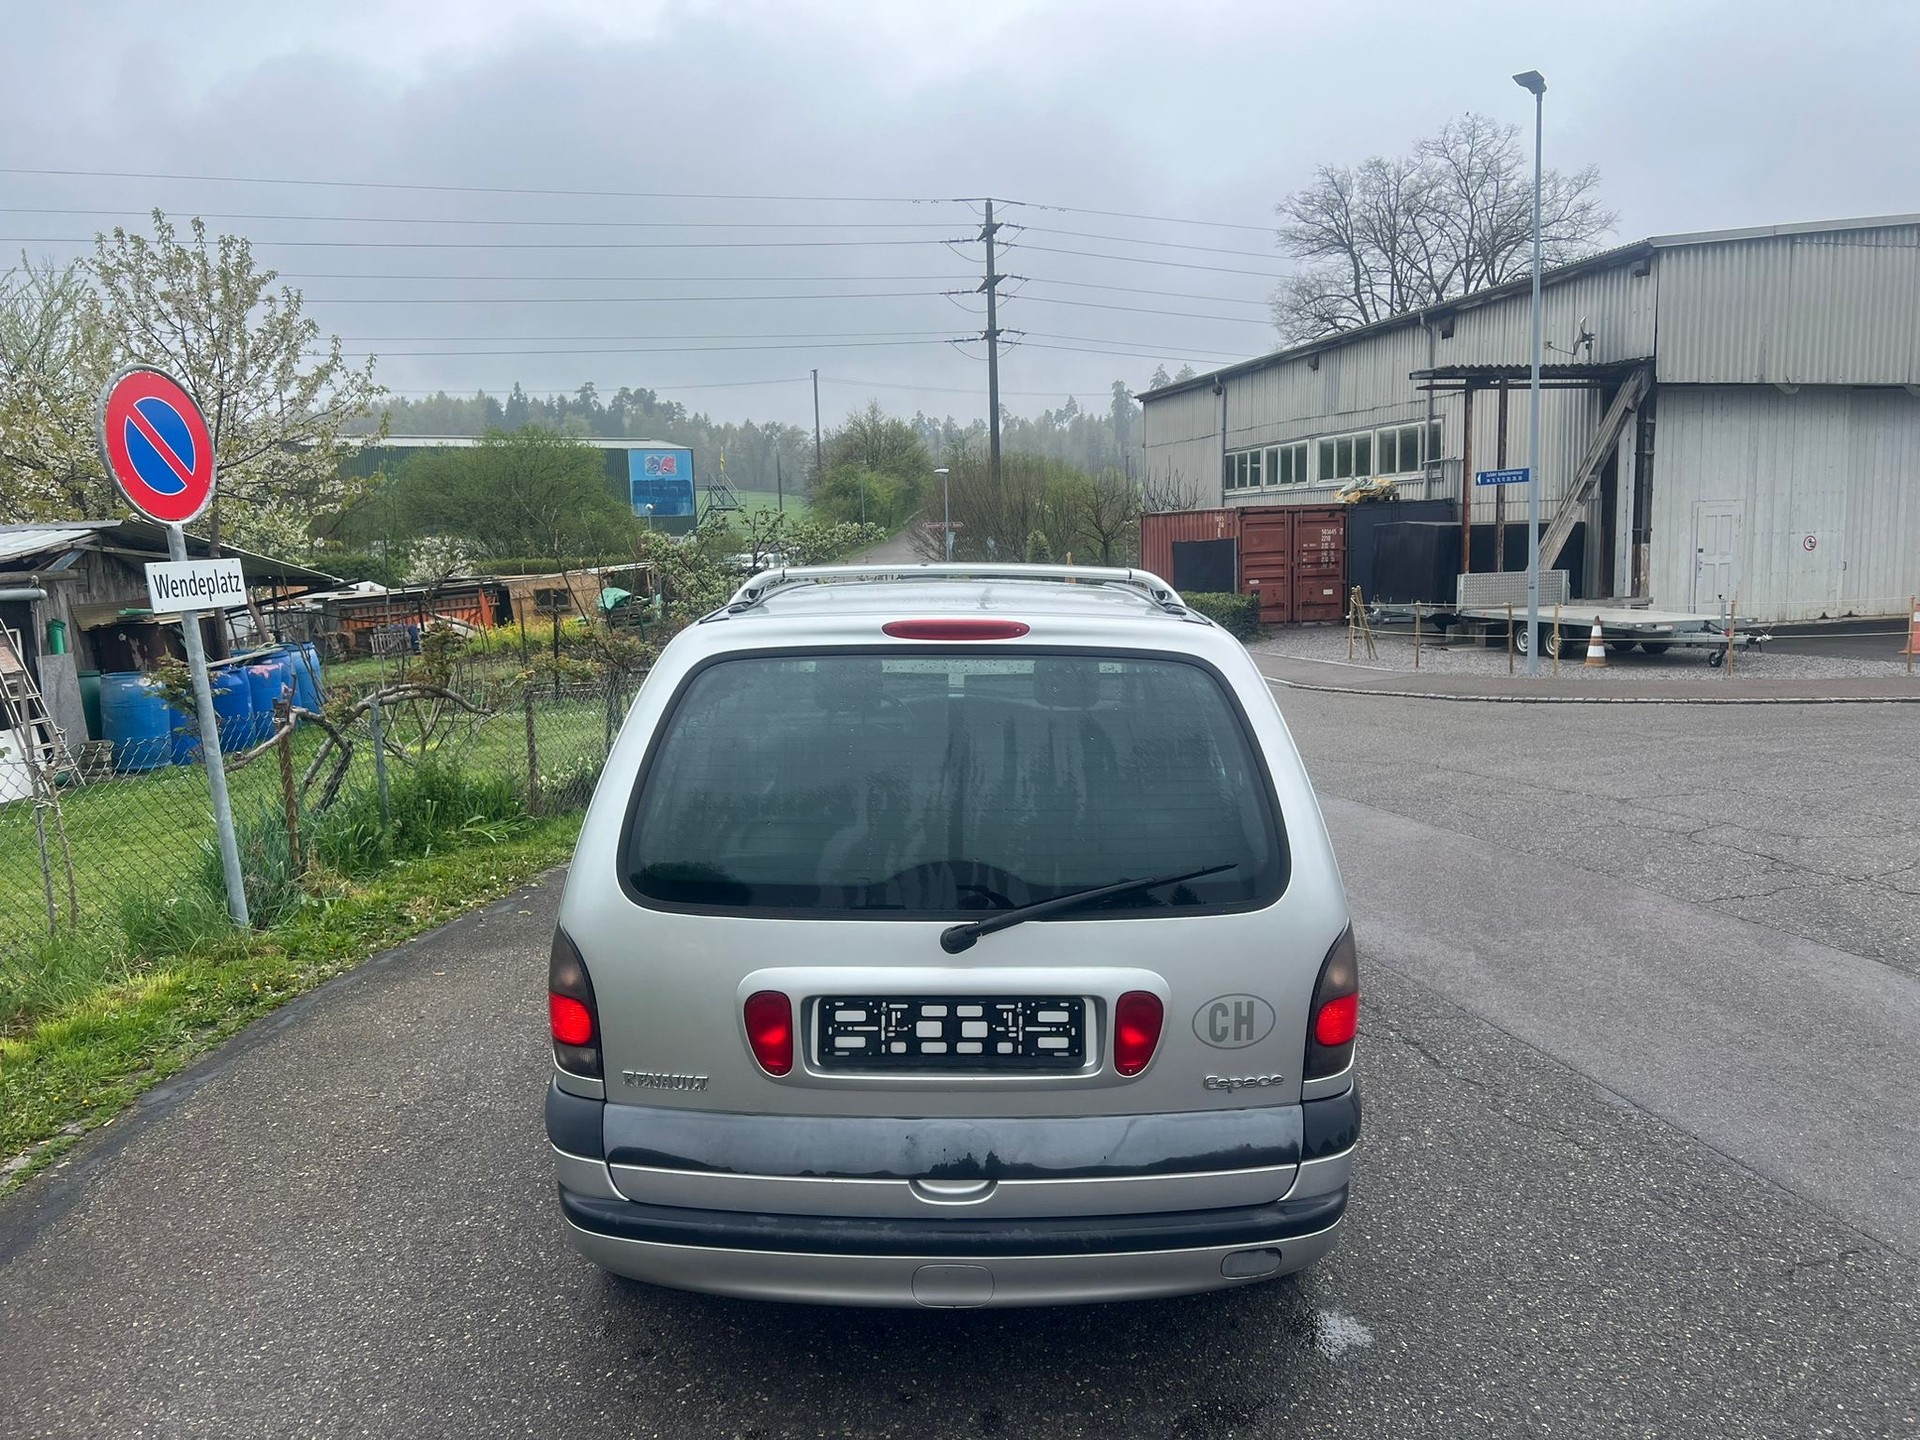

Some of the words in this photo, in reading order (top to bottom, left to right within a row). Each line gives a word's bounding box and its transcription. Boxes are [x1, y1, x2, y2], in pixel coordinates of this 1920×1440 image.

[153, 569, 242, 602] Wendeplatz
[1209, 1001, 1254, 1043] CH
[622, 1070, 708, 1091] RENAULT
[1203, 1074, 1284, 1094] Espace
